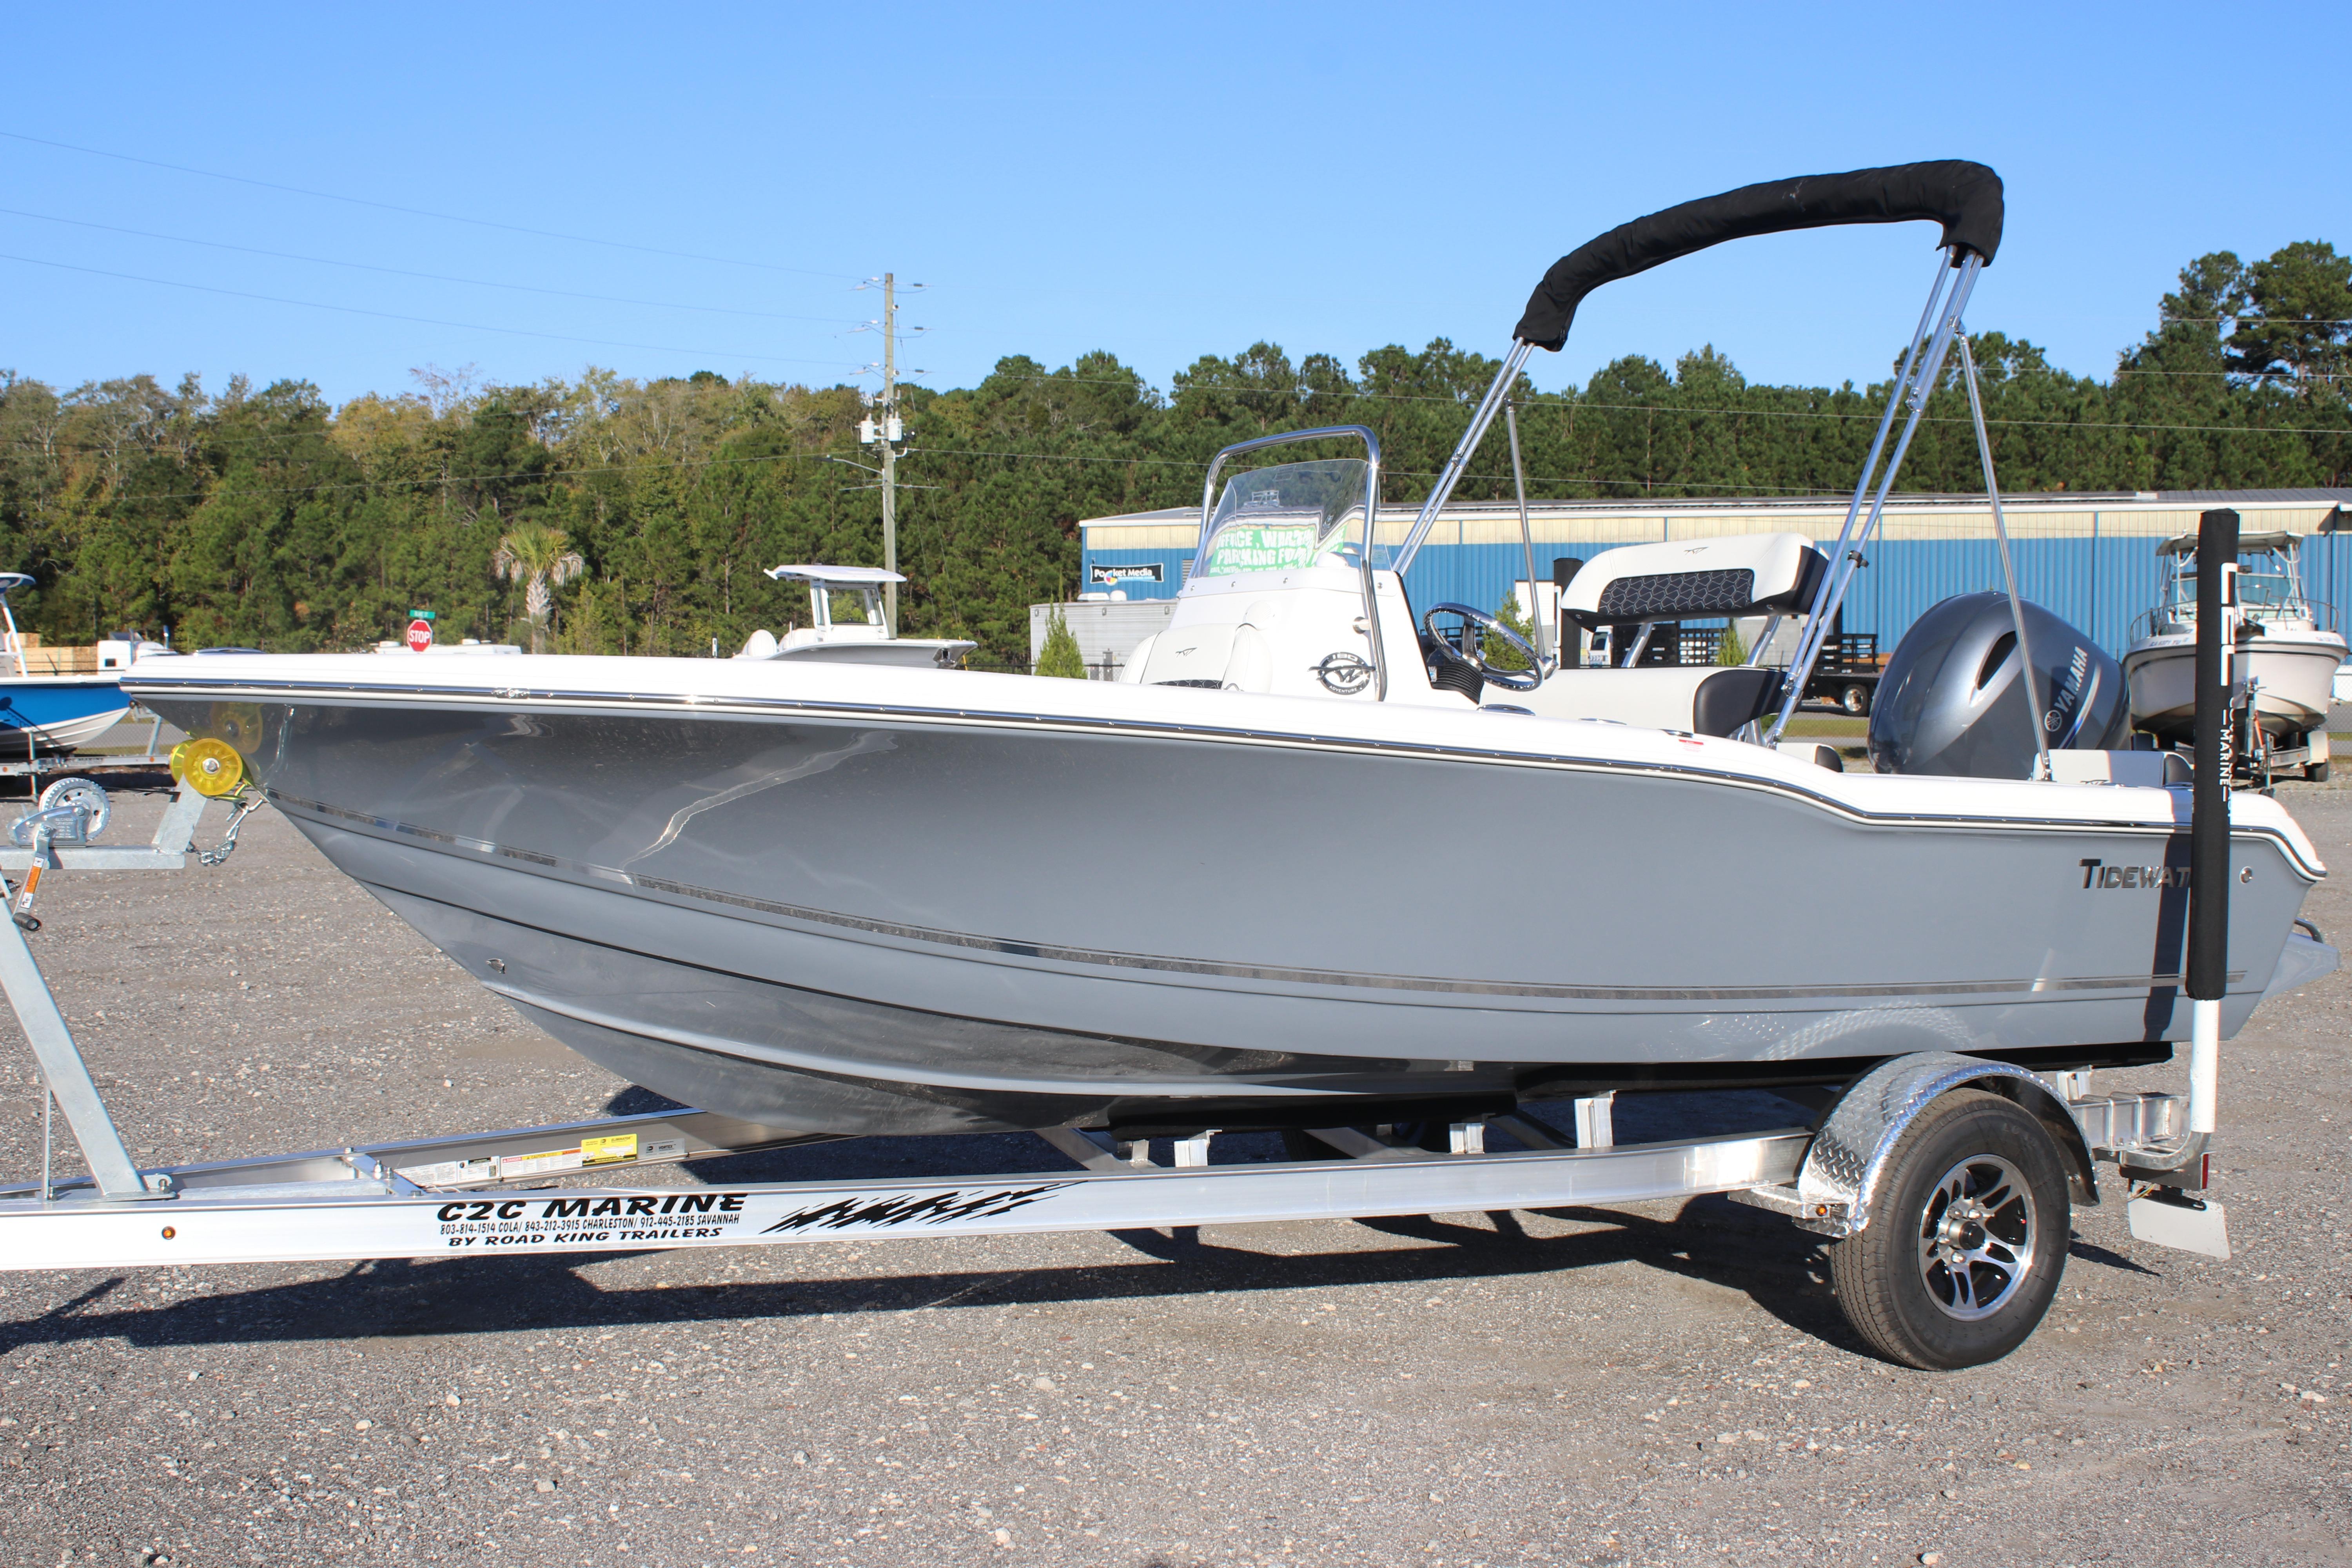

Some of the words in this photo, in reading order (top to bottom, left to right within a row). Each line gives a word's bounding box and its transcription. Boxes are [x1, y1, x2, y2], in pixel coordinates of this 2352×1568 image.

[1094, 568, 1127, 585] Pocket
[1128, 568, 1152, 577] Media
[409, 630, 430, 643] STOP
[2054, 646, 2088, 713] YAMAHA
[2219, 728, 2230, 786] MARINE
[2079, 858, 2191, 889] TIDEWAT
[437, 1201, 526, 1221] C2C
[542, 1193, 748, 1218] MARINE
[441, 1222, 496, 1234] 803-814-1514
[499, 1221, 523, 1233] COLA/
[525, 1219, 580, 1232] 843-212-3915
[583, 1216, 638, 1230] CHARLESTON/
[641, 1215, 695, 1228] 912-445-2185
[697, 1214, 740, 1226] SAVANNAH
[449, 1237, 477, 1246] BY
[485, 1234, 545, 1245] ROAD
[554, 1231, 610, 1243] KING
[619, 1227, 723, 1240] TRAILERS
